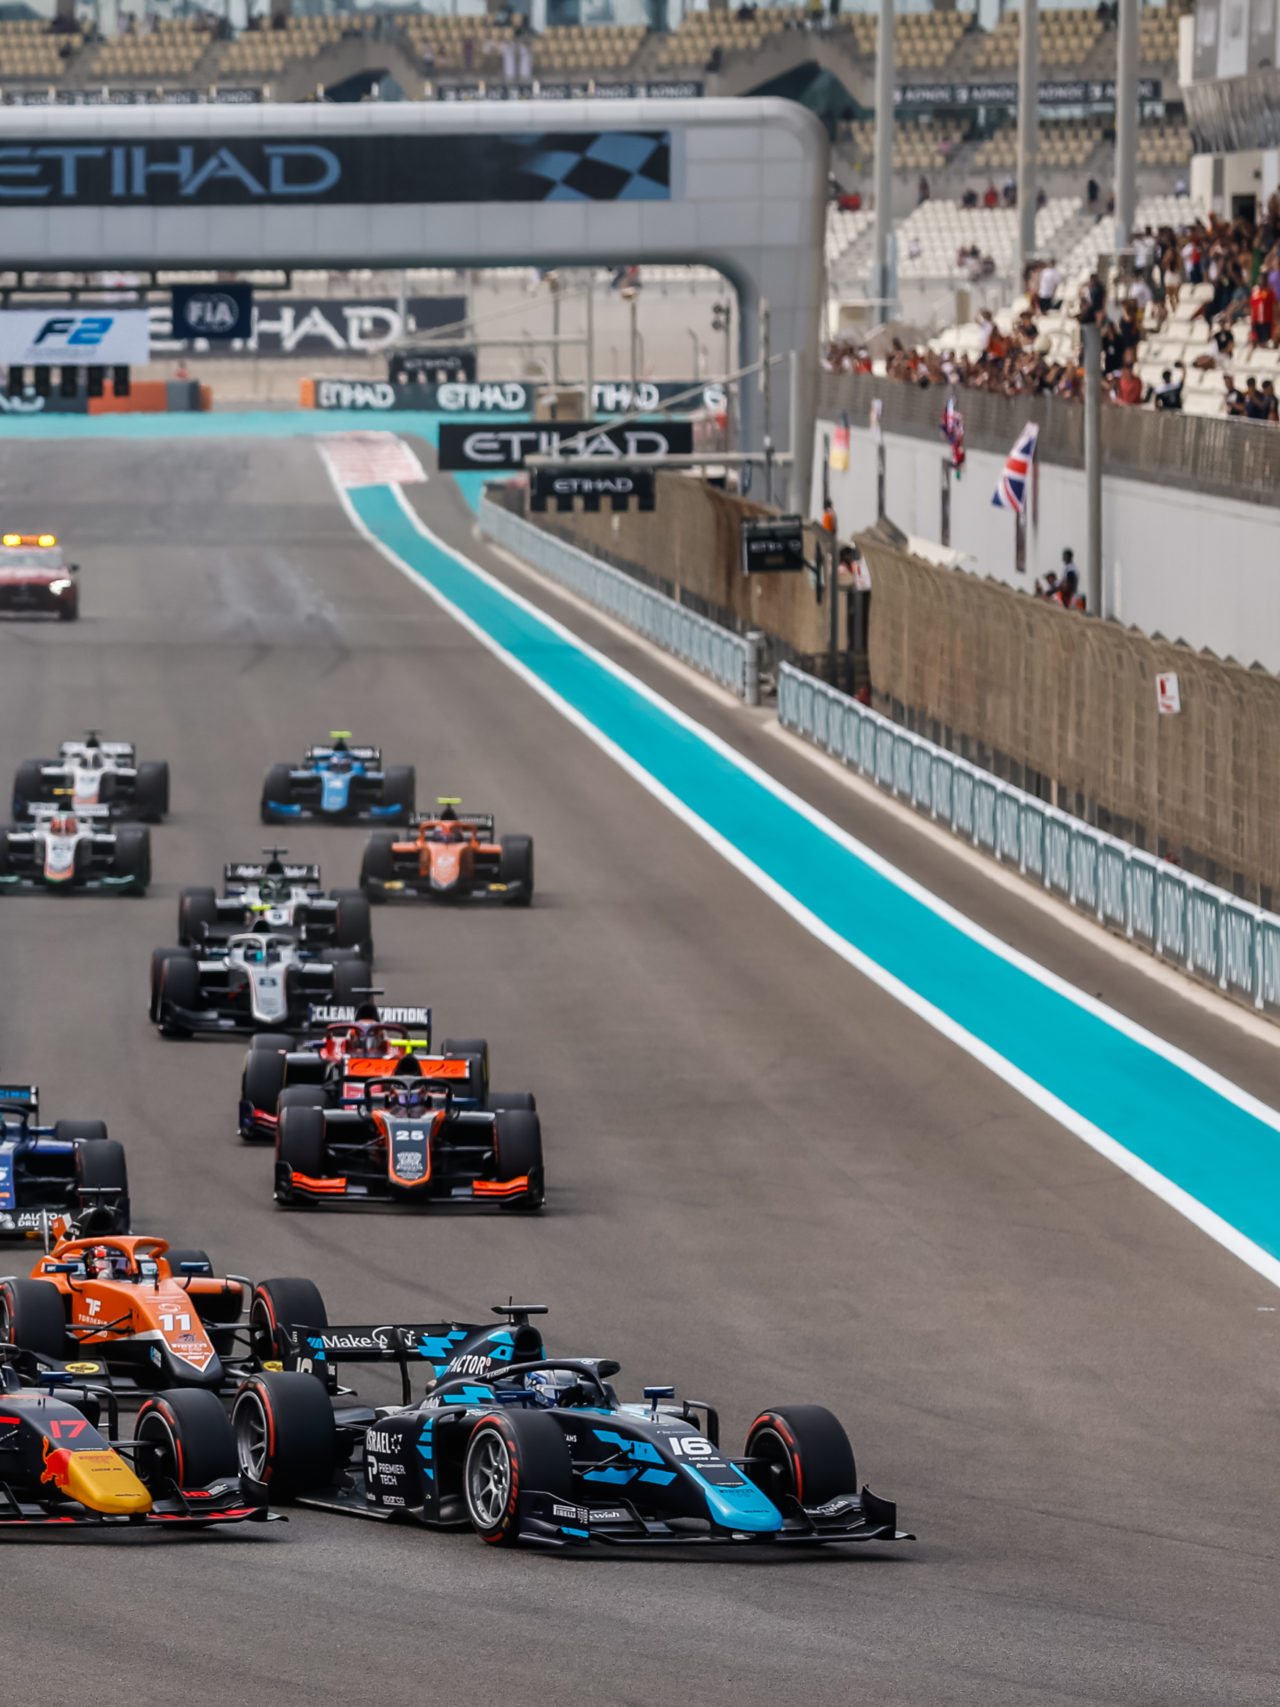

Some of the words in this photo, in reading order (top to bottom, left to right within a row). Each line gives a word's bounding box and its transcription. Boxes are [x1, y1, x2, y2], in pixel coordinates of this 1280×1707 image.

[187, 301, 234, 324] FIA
[34, 317, 113, 346] F2
[149, 305, 400, 351] EHAD
[437, 383, 525, 411] ETIHAD
[592, 384, 659, 410] TIHAD
[463, 430, 669, 464] ETIHAD
[553, 477, 633, 493] ETIHAD
[378, 1007, 426, 1024] TRITION
[395, 1130, 425, 1141] 25
[157, 1313, 192, 1332] 11
[50, 1420, 88, 1439] 17
[366, 1430, 391, 1453] ISRAEL
[668, 1437, 713, 1456] 16
[380, 1474, 398, 1485] TECH
